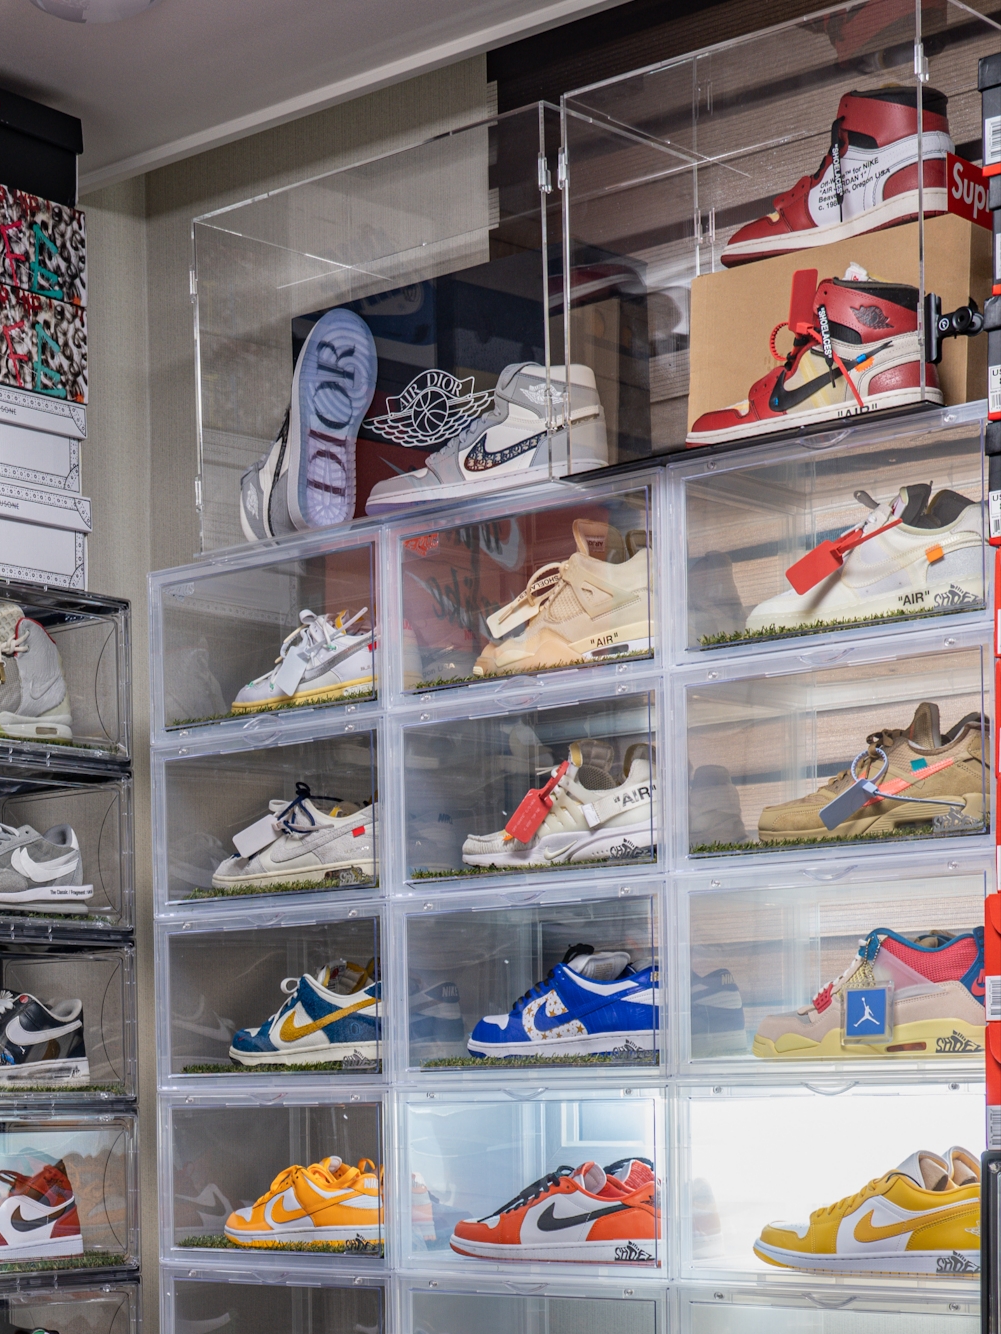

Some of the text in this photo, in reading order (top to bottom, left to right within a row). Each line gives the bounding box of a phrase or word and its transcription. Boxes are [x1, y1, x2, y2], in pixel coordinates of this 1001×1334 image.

[852, 166, 862, 174] for
[862, 157, 879, 170] NIKE
[818, 188, 851, 204] Beaveon,
[851, 175, 873, 191] Oregon
[834, 175, 859, 191] JRDAN
[826, 200, 841, 210] 198
[399, 372, 463, 411] AIR DIOR
[306, 340, 357, 497] DIOR
[898, 590, 930, 606] "AIR"
[590, 632, 619, 647] "AIR"
[614, 785, 656, 807] "AIR"
